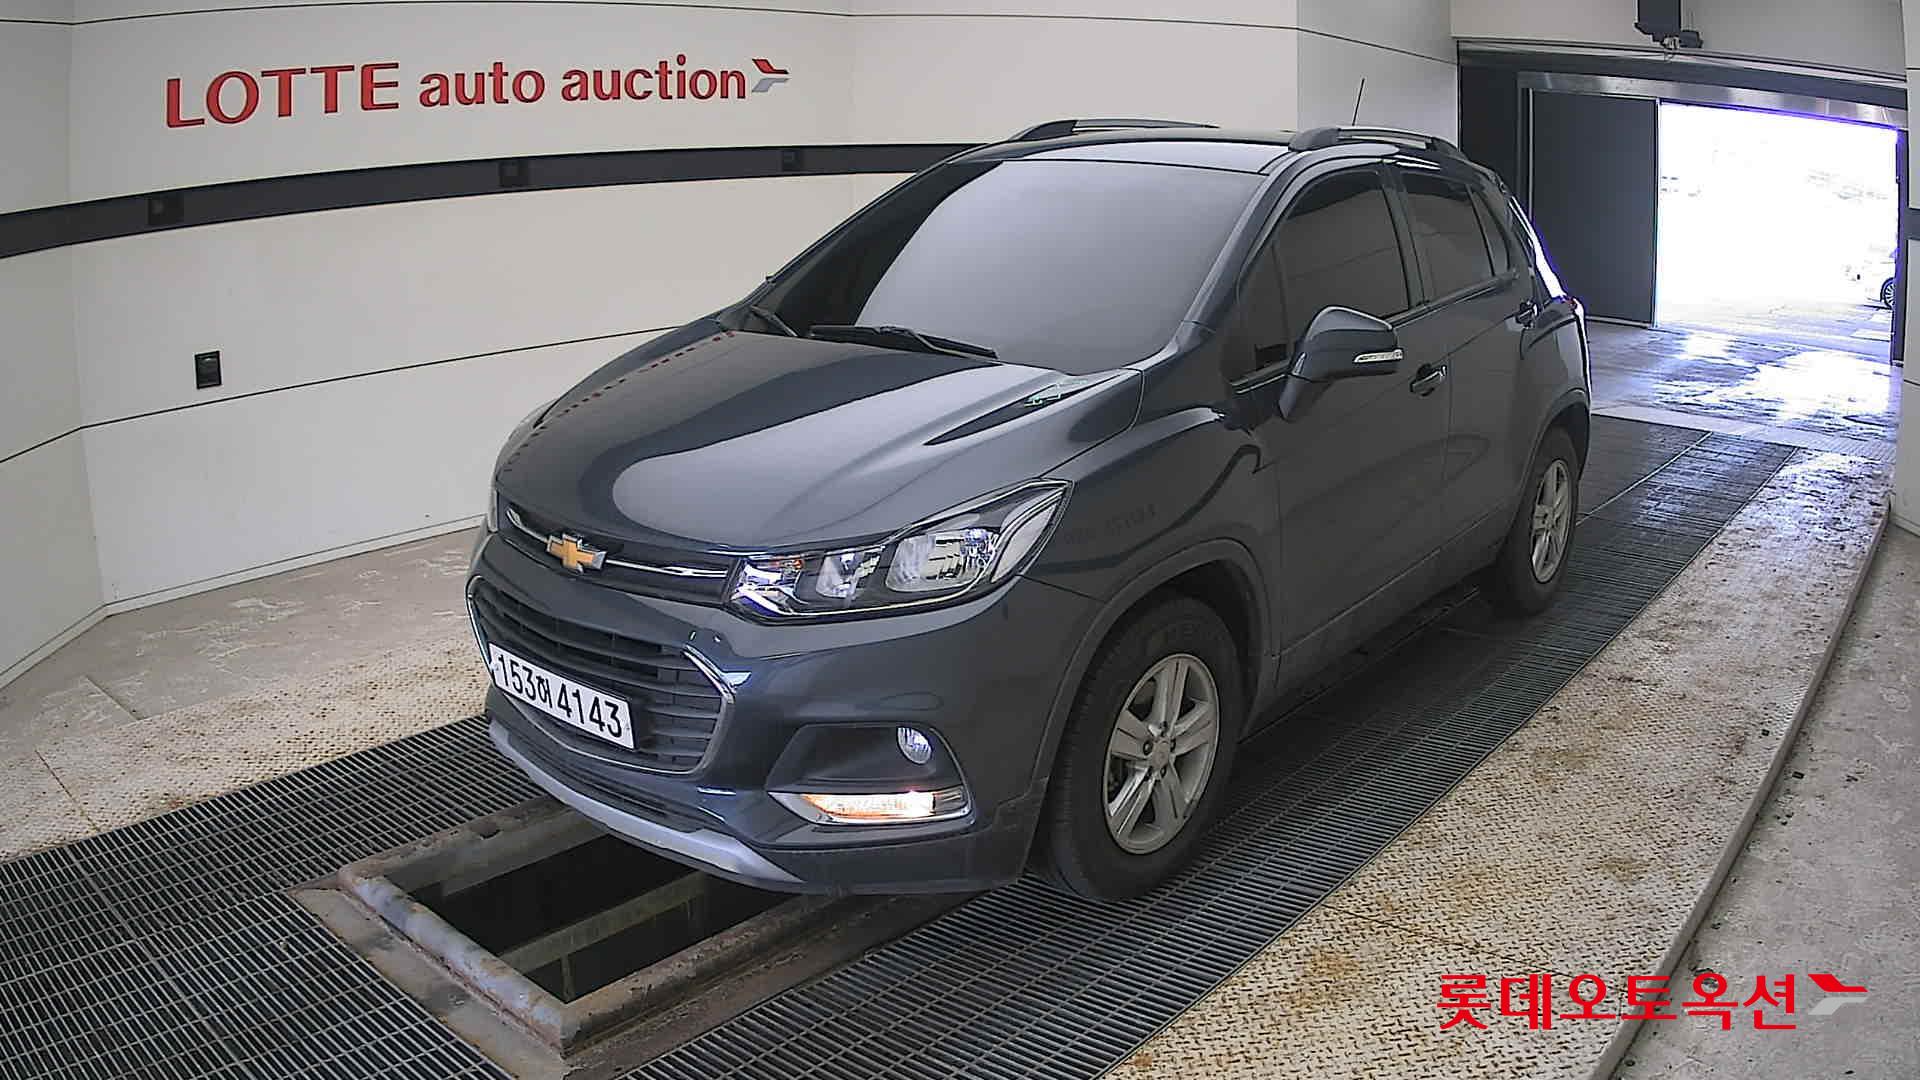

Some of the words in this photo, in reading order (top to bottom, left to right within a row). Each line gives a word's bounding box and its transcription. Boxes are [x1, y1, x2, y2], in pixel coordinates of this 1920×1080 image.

[166, 62, 399, 128] LOTTE
[419, 62, 545, 107] auto
[561, 54, 747, 101] auction
